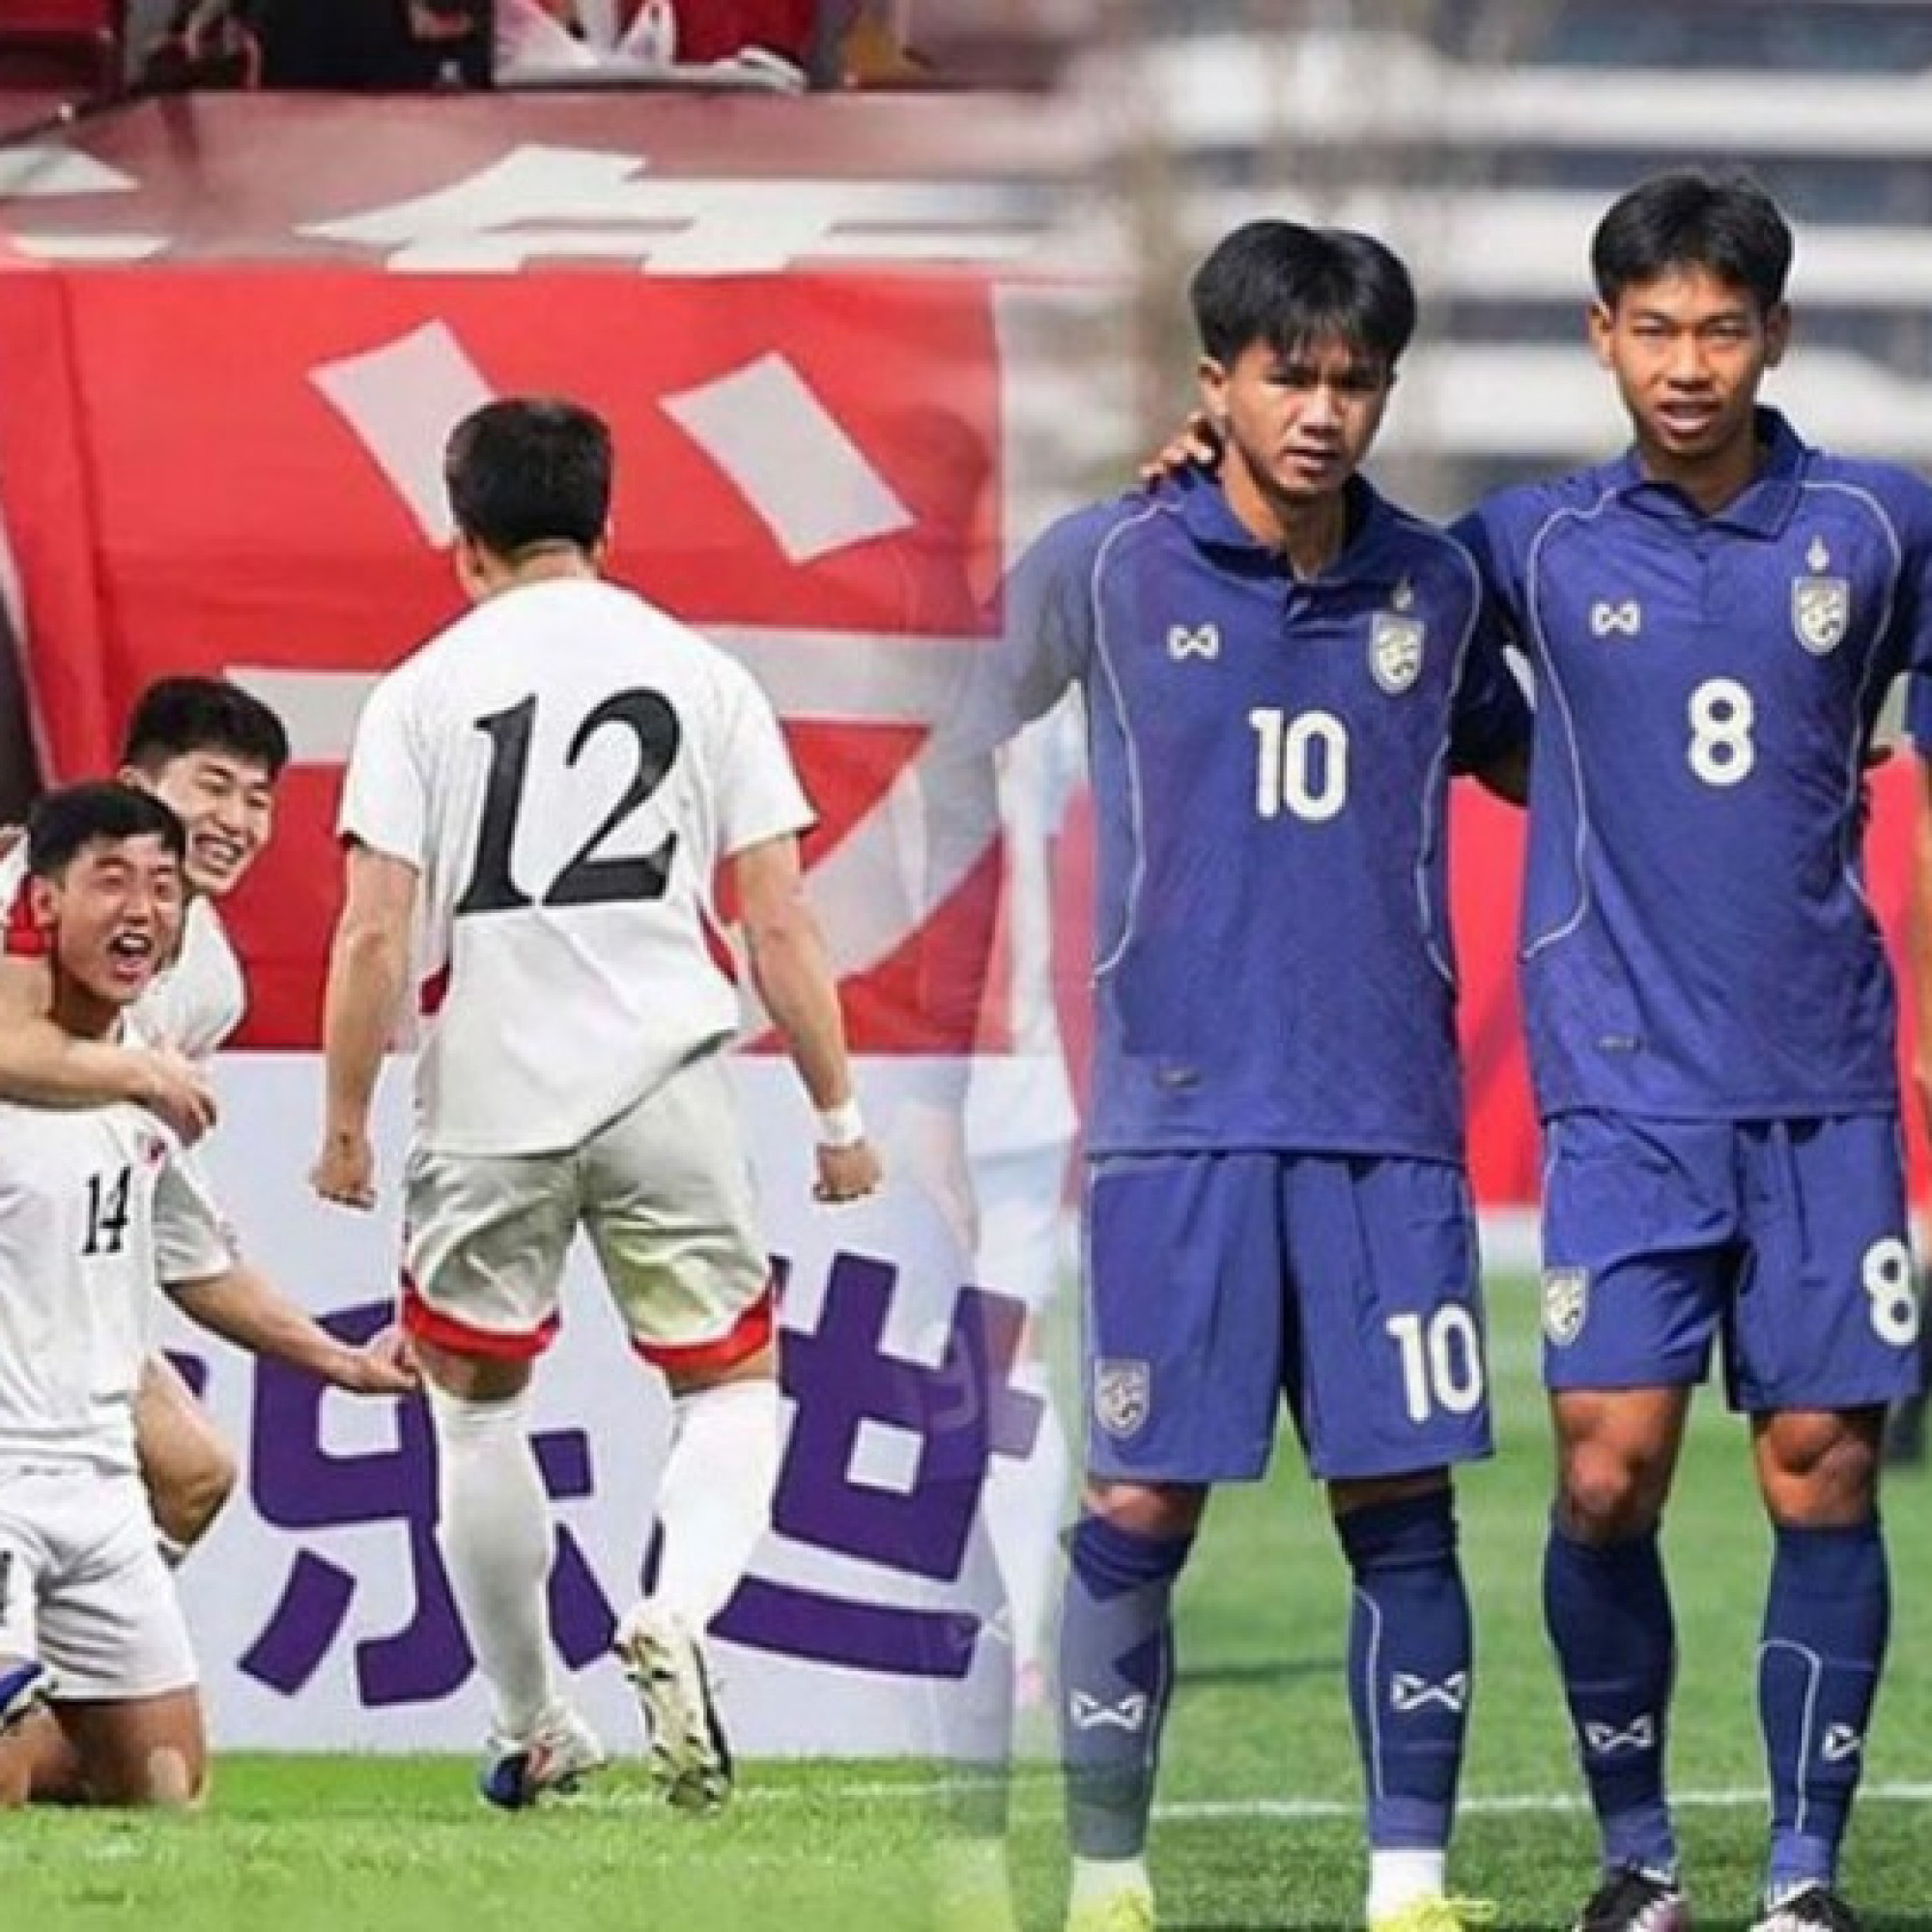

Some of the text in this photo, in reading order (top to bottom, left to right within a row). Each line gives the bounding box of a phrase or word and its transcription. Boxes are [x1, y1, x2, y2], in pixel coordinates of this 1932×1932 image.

[1248, 707, 1349, 821] 10
[1688, 678, 1755, 785] 8
[454, 687, 681, 915] 12
[81, 1163, 131, 1256] 14
[1861, 1237, 1920, 1346] 8
[1385, 1302, 1485, 1424] 10
